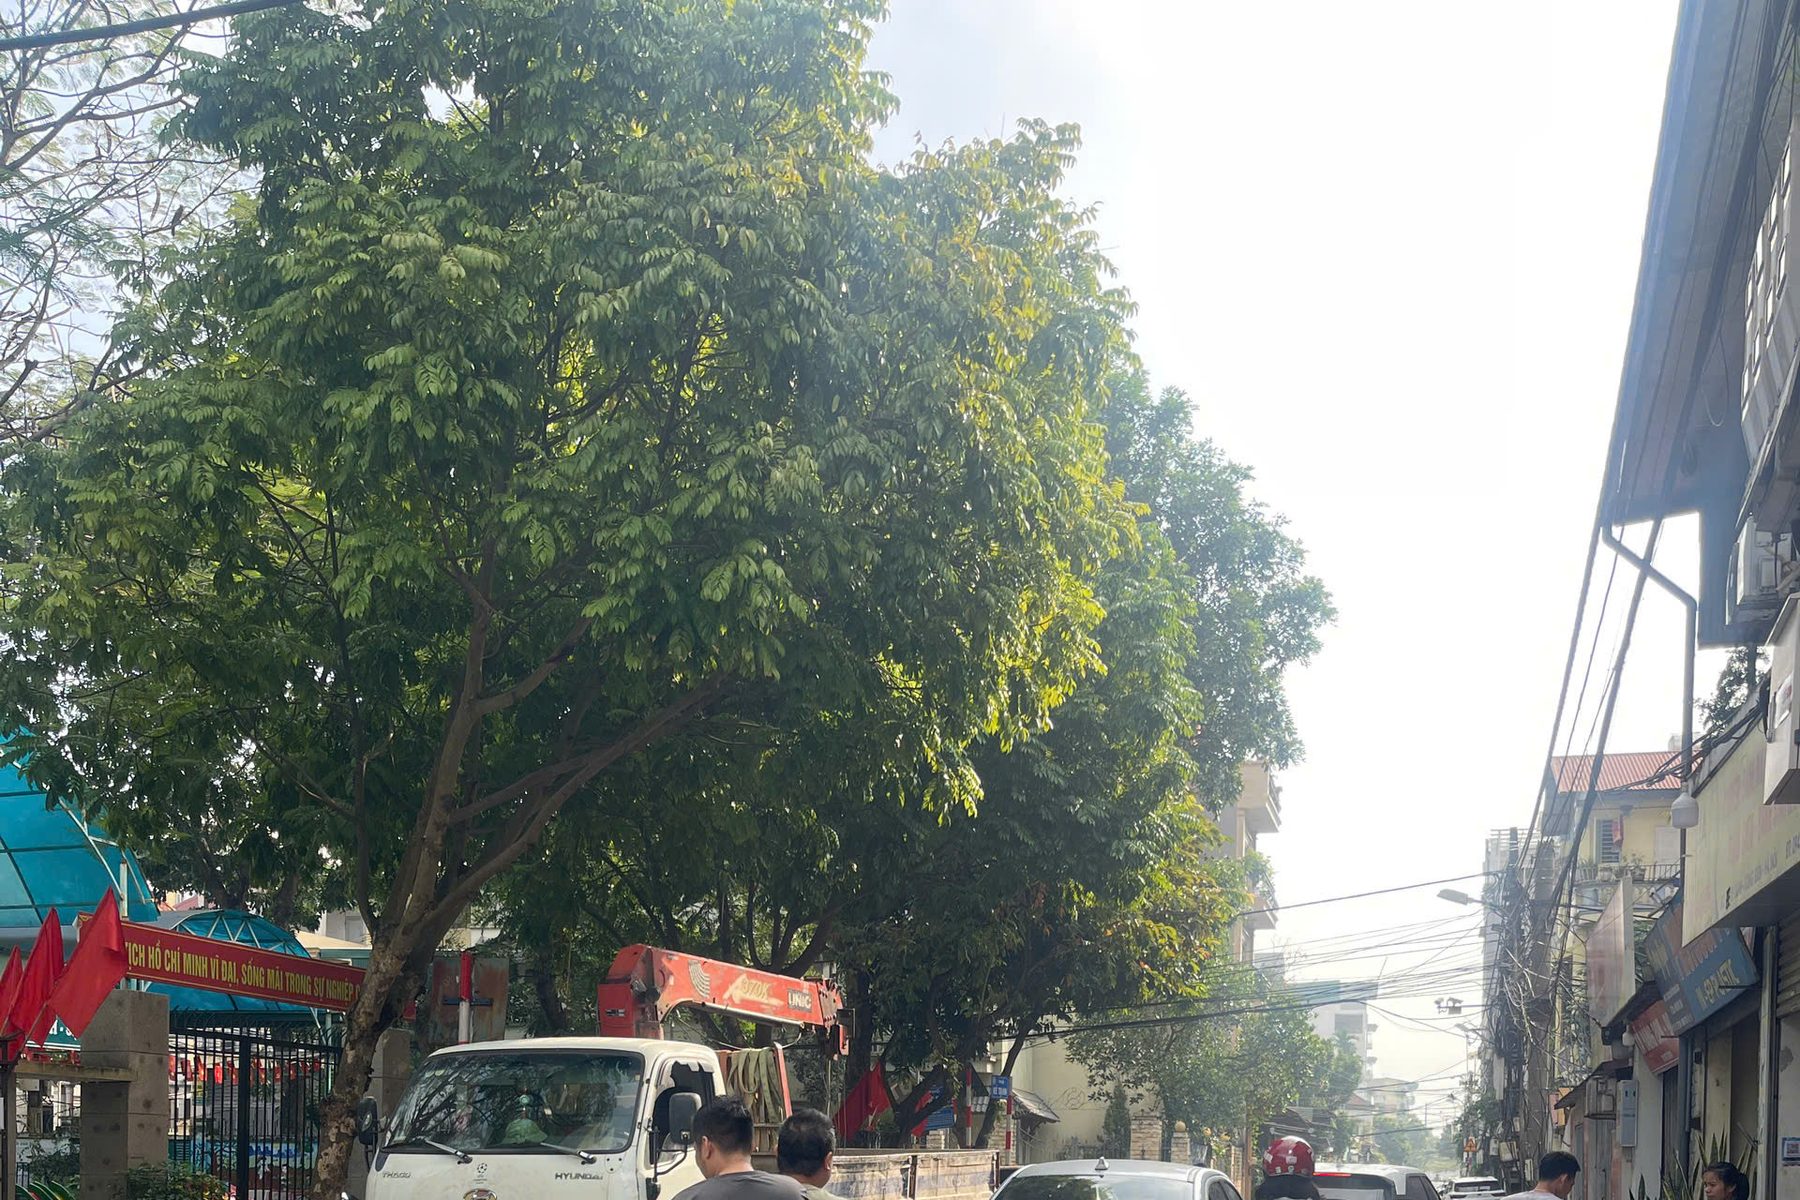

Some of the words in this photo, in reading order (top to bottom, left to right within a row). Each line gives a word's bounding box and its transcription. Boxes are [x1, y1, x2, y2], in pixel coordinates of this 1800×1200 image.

[164, 947, 180, 973] CHÍ
[183, 952, 208, 978] MINH
[241, 958, 265, 988] SỐNG
[267, 966, 284, 991] MÃI
[285, 971, 311, 994] TRONG
[313, 976, 325, 1001] SỰ
[326, 977, 353, 1005] NGHIỆP
[787, 991, 813, 1010] UNIC
[554, 1172, 604, 1181] HYUNDAI
